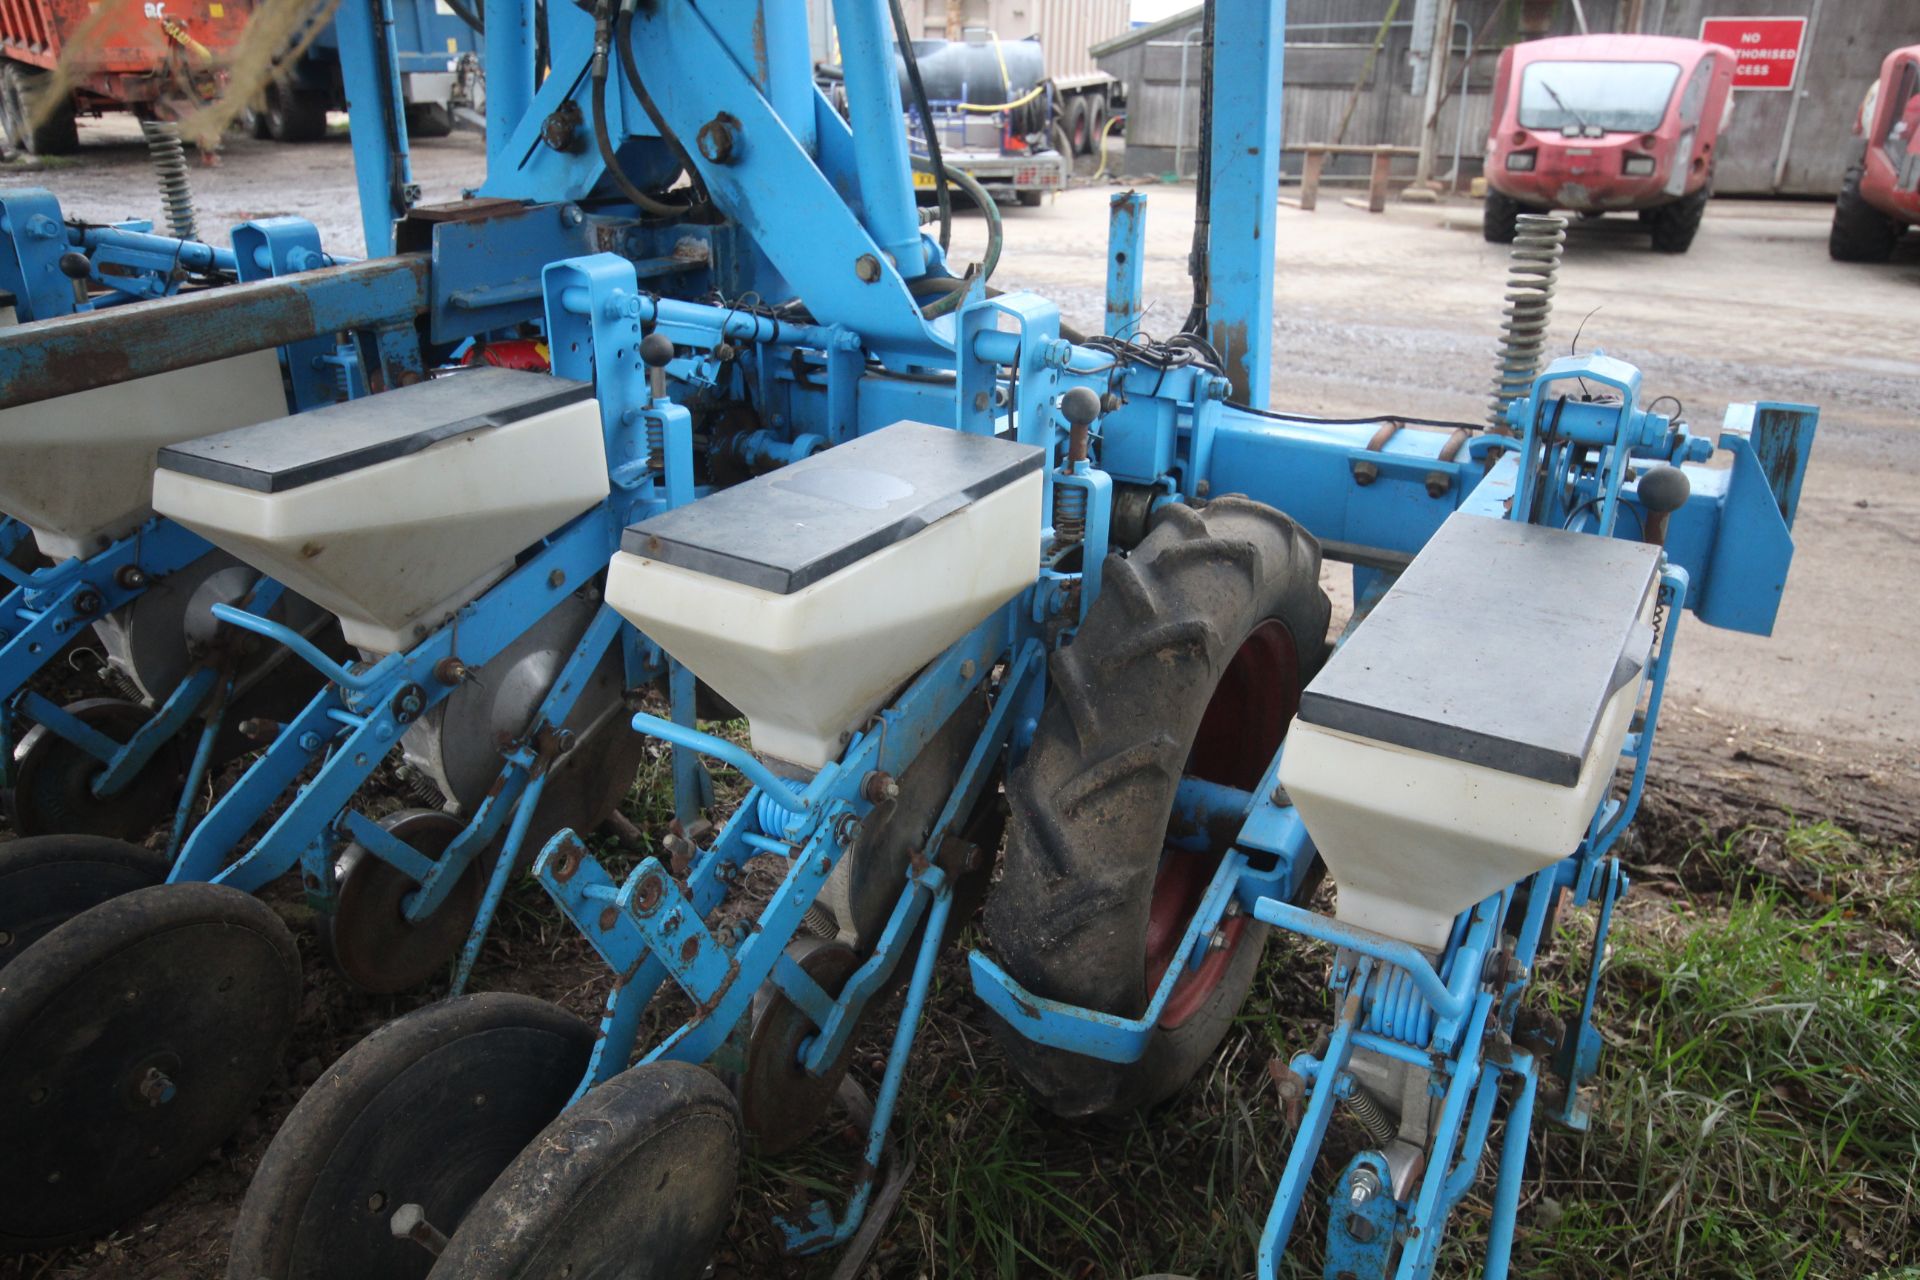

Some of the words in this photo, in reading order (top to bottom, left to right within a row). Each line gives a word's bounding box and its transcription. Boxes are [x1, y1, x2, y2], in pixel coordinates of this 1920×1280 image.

[1741, 32, 1761, 43] NO
[1735, 48, 1796, 60] THORISED
[1736, 64, 1769, 76] CESS
